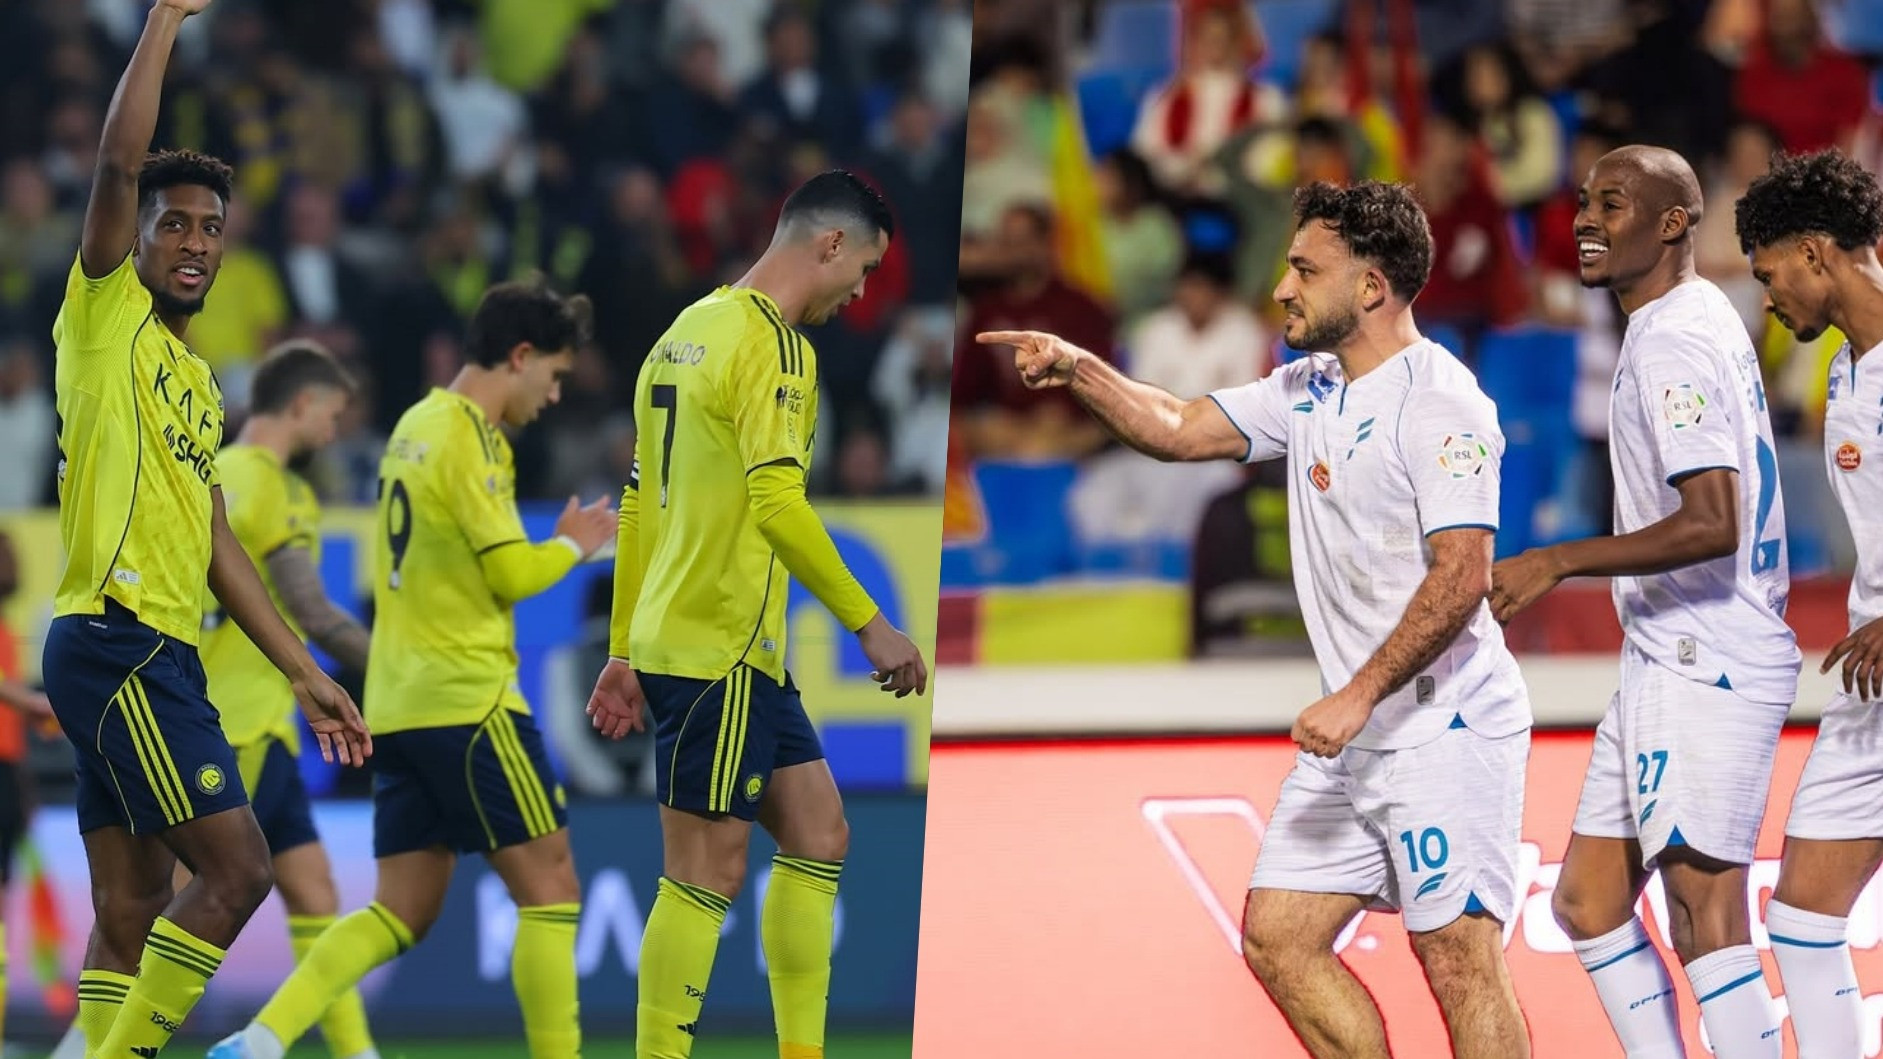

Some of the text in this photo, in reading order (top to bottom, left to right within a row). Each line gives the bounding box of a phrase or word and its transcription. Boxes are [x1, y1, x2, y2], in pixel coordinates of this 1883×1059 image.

[651, 384, 678, 508] 7
[1454, 450, 1472, 460] RSL
[1637, 750, 1668, 795] 27
[1400, 827, 1449, 873] 10
